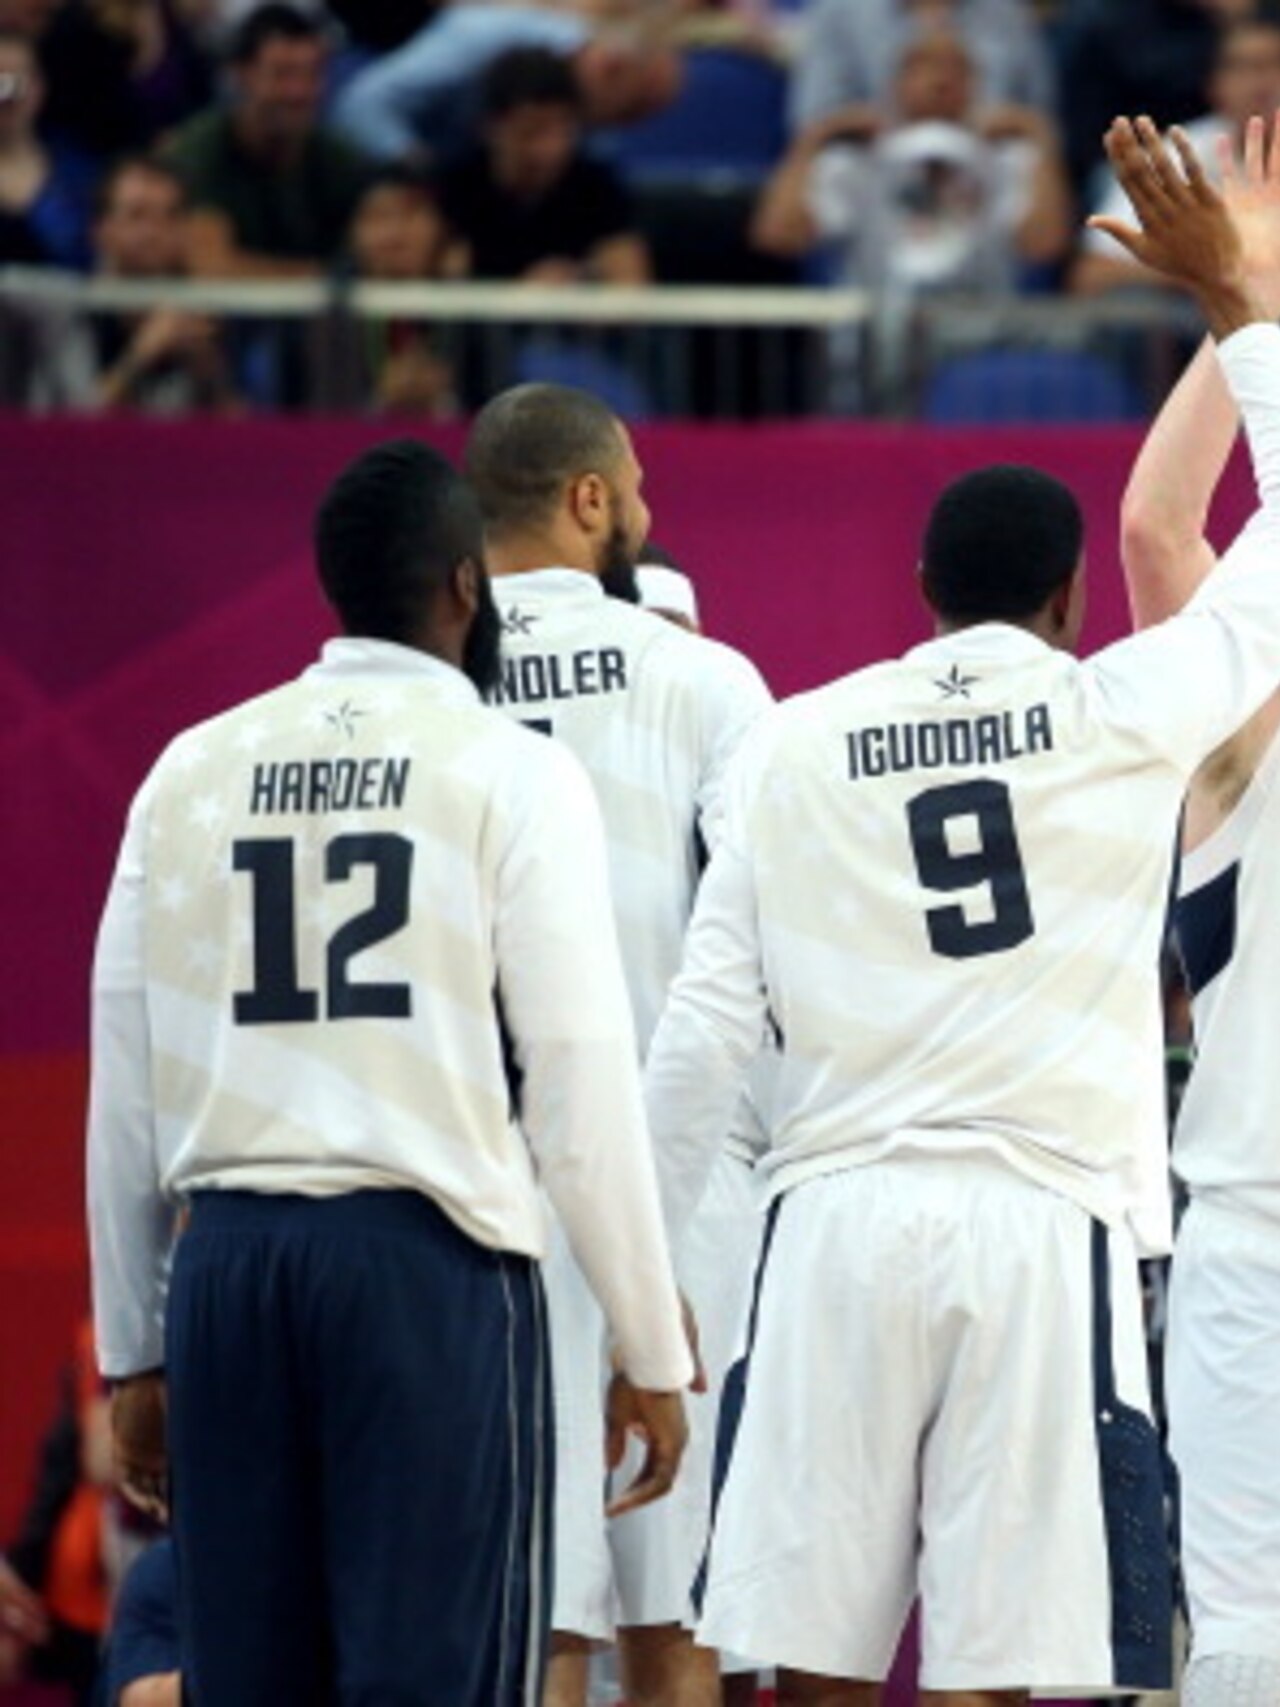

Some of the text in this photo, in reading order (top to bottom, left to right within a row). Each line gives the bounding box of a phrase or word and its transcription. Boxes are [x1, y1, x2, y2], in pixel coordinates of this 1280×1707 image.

[486, 647, 627, 706] NDLER
[846, 703, 1053, 780] IGUODALA
[249, 757, 411, 815] HARDEN
[905, 776, 1035, 961] 9
[232, 831, 415, 1026] 12
